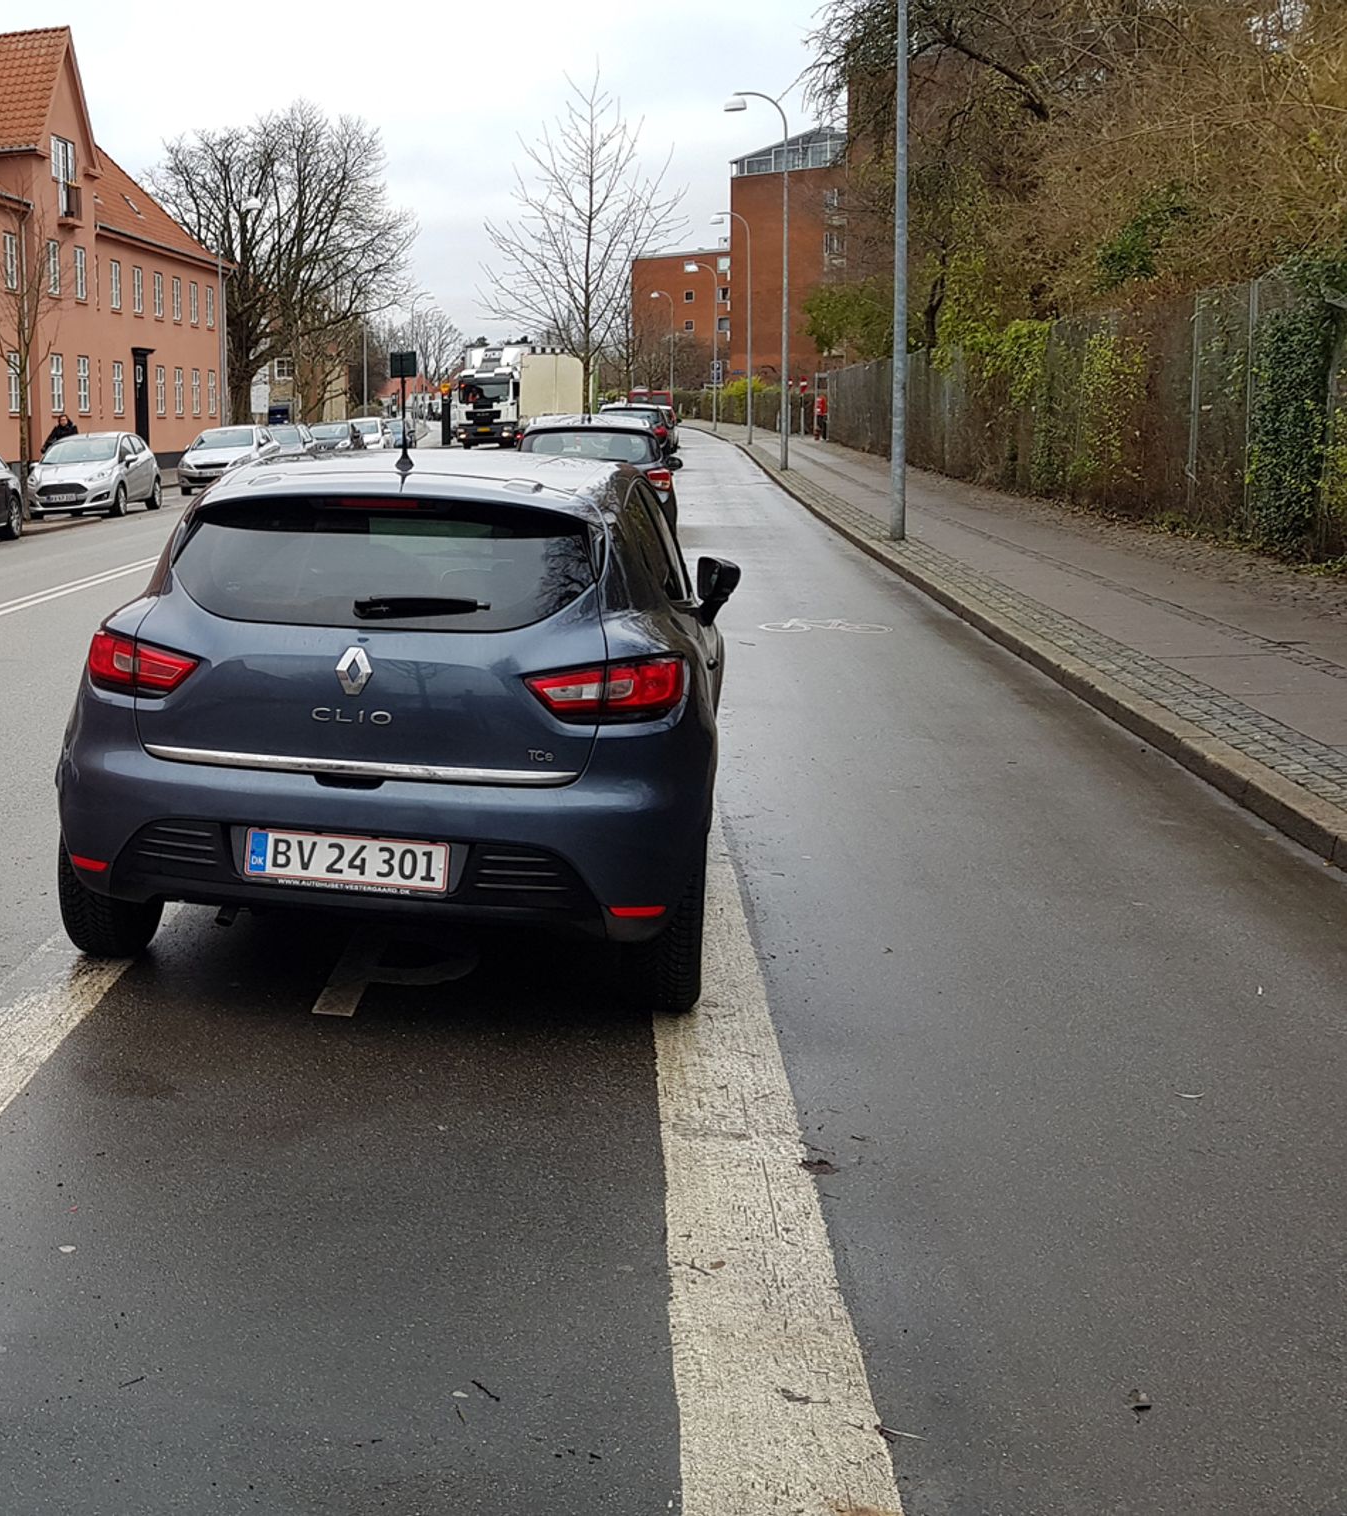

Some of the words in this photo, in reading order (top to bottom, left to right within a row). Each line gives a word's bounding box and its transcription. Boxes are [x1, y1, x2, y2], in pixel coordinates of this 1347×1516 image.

[311, 707, 392, 725] CLIO
[528, 749, 554, 762] TCe
[251, 856, 264, 866] DK
[271, 838, 317, 871] BV
[325, 842, 367, 876] 24
[376, 846, 436, 882] 301
